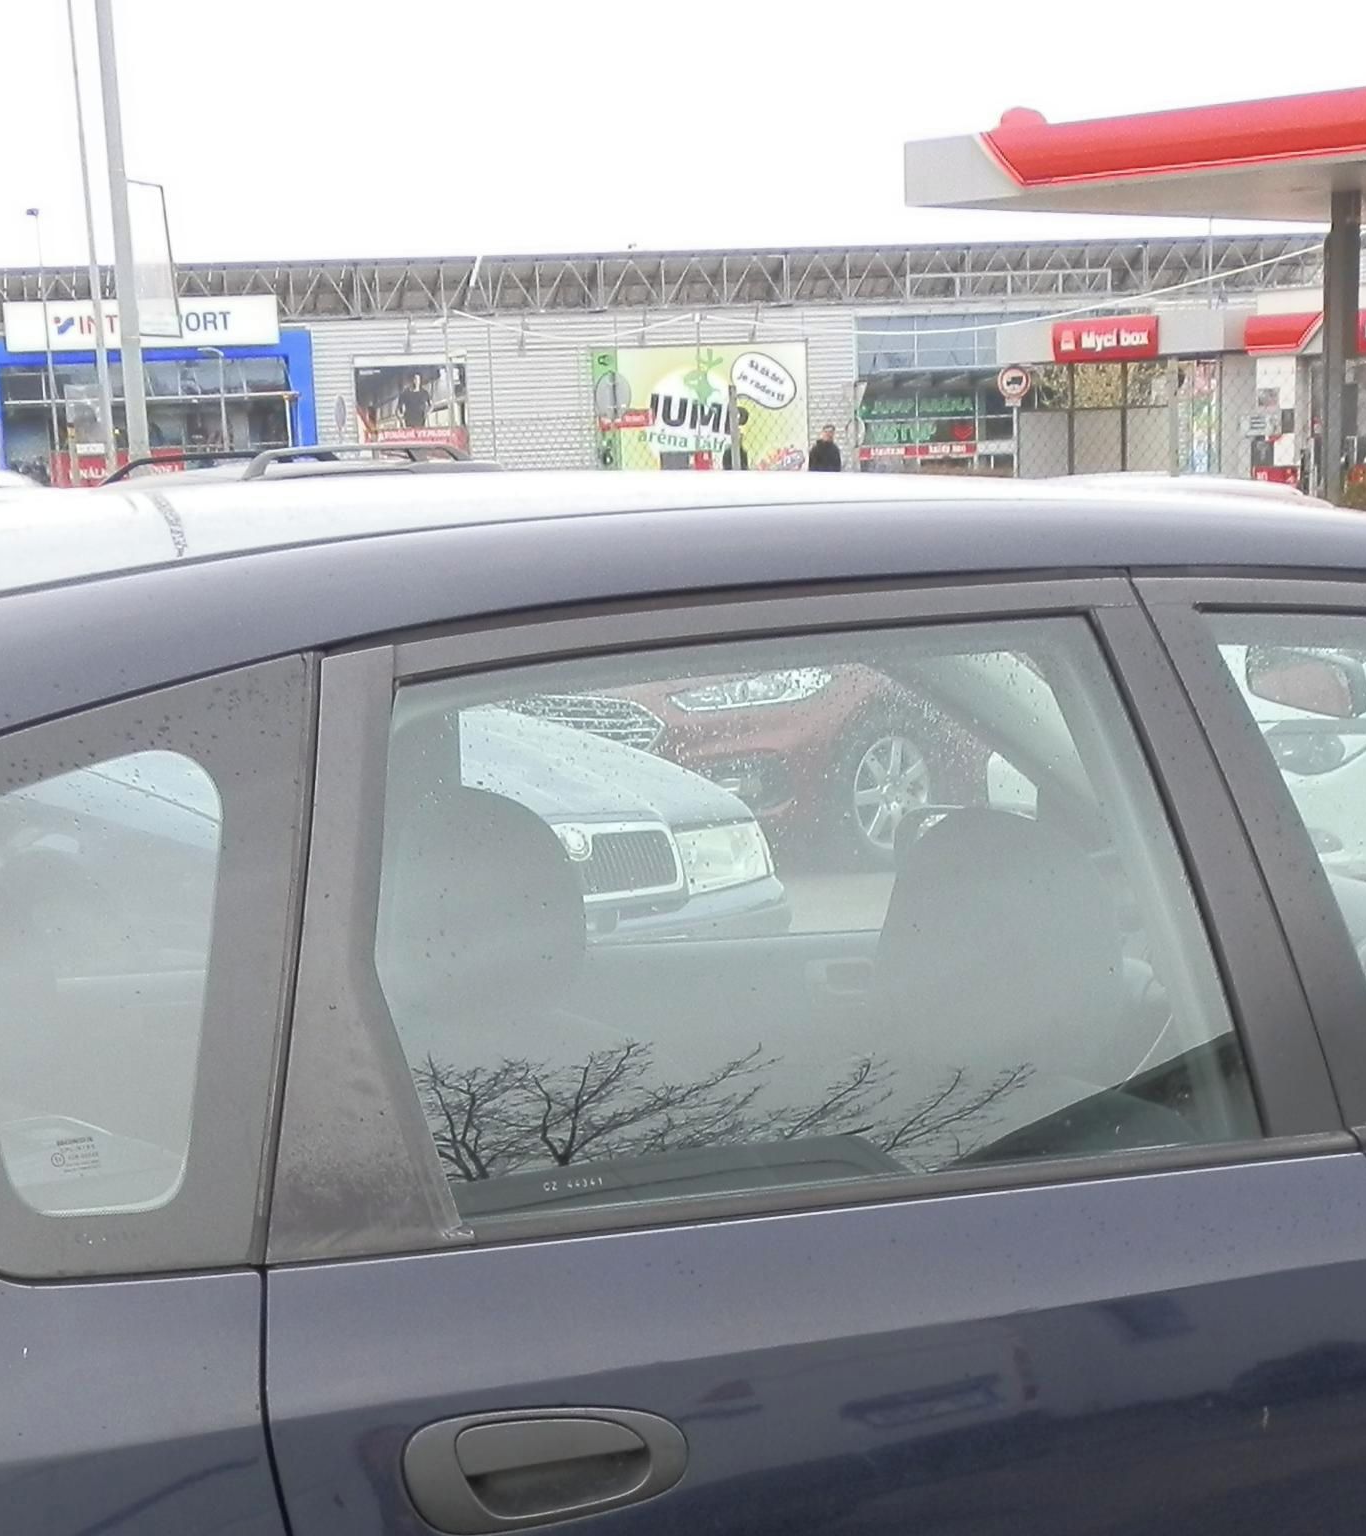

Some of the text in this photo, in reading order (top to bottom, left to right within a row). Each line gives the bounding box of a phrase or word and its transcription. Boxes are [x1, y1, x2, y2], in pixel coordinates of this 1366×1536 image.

[79, 311, 231, 335] INTORT
[1081, 327, 1149, 352] Mycí box
[638, 428, 688, 448] aréna
[543, 1181, 558, 1192] CZ
